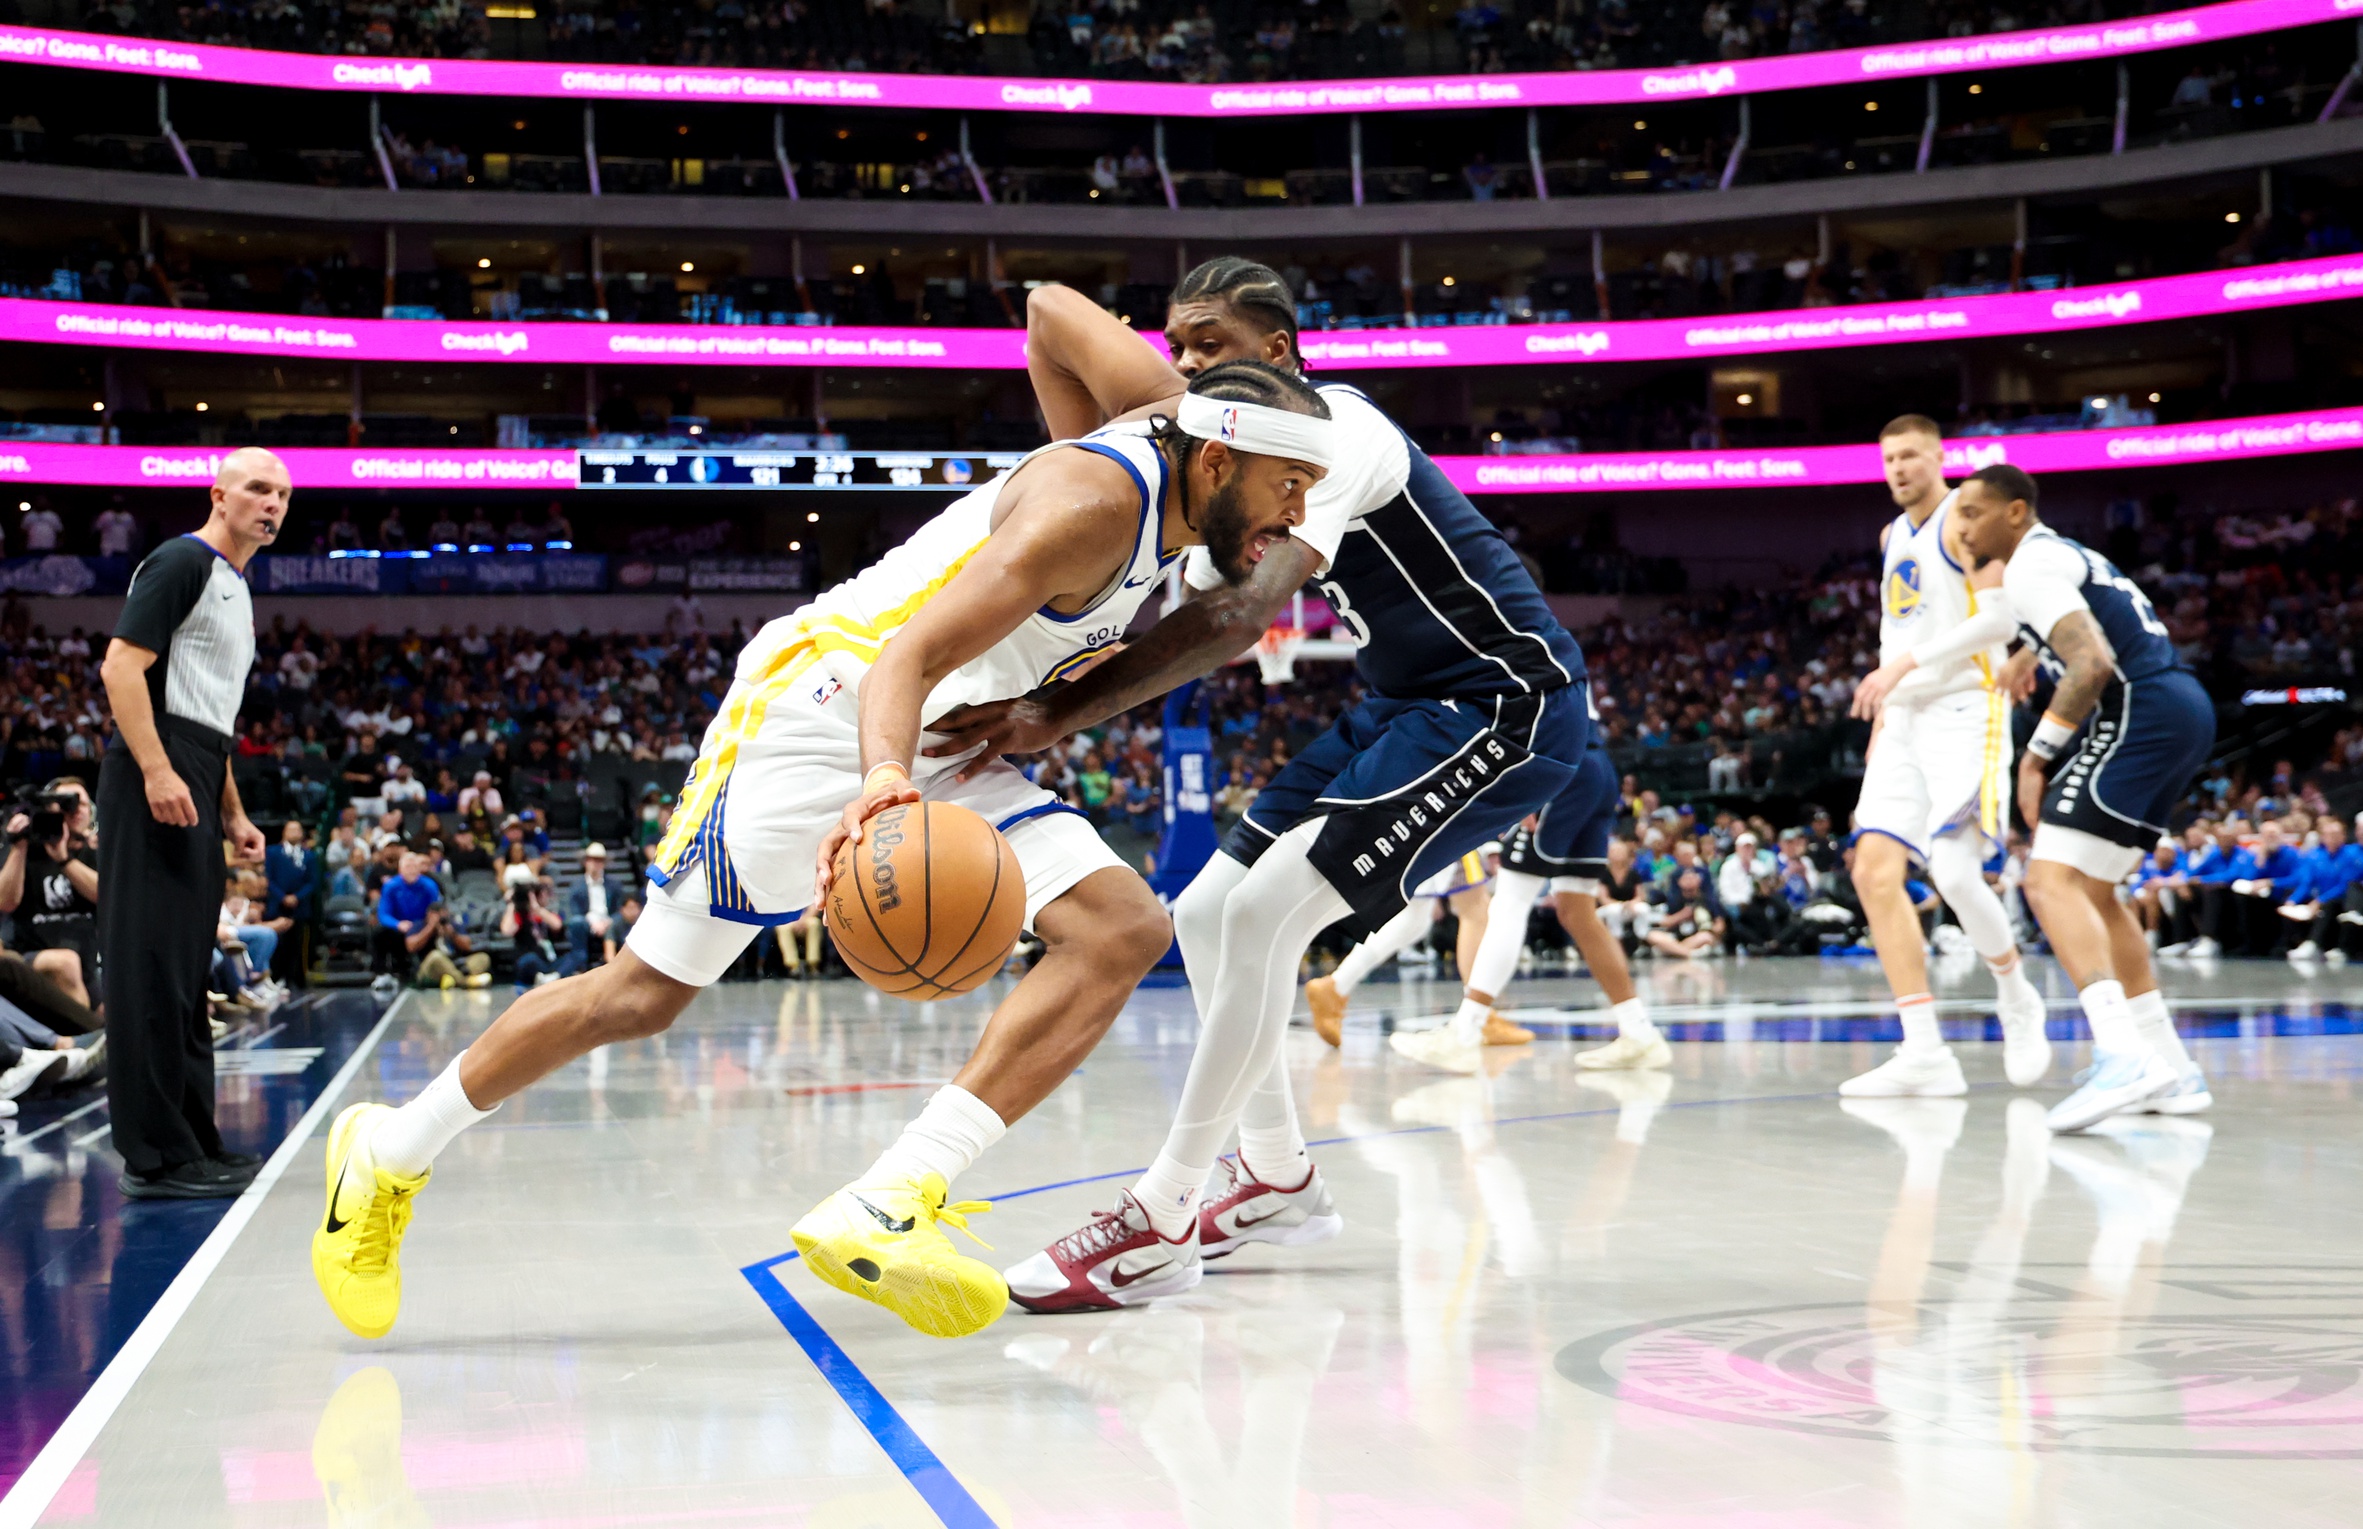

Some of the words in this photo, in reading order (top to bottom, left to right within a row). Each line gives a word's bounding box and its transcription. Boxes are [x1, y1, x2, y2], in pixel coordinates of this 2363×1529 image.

[333, 63, 394, 84] Check
[561, 71, 626, 91] Official
[663, 75, 682, 92] of
[1642, 73, 1699, 94] Check
[1001, 84, 1057, 104] Check
[1210, 90, 1271, 109] Official
[1307, 88, 1327, 106] of
[2224, 278, 2283, 299] Official
[2320, 270, 2341, 287] of
[2052, 298, 2106, 318] Check
[56, 315, 118, 334] Official
[119, 320, 152, 336] ride
[153, 321, 171, 337] of
[442, 333, 496, 350] Check
[1526, 335, 1576, 352] Check
[2107, 437, 2178, 458] Official
[2218, 430, 2240, 449] of
[141, 456, 209, 476] Check
[352, 459, 422, 478] Official
[423, 459, 461, 479] ride
[463, 459, 484, 479] of
[1476, 466, 1541, 484] Official
[1579, 464, 1599, 482] of
[1352, 739, 1506, 877] MAVERICKS
